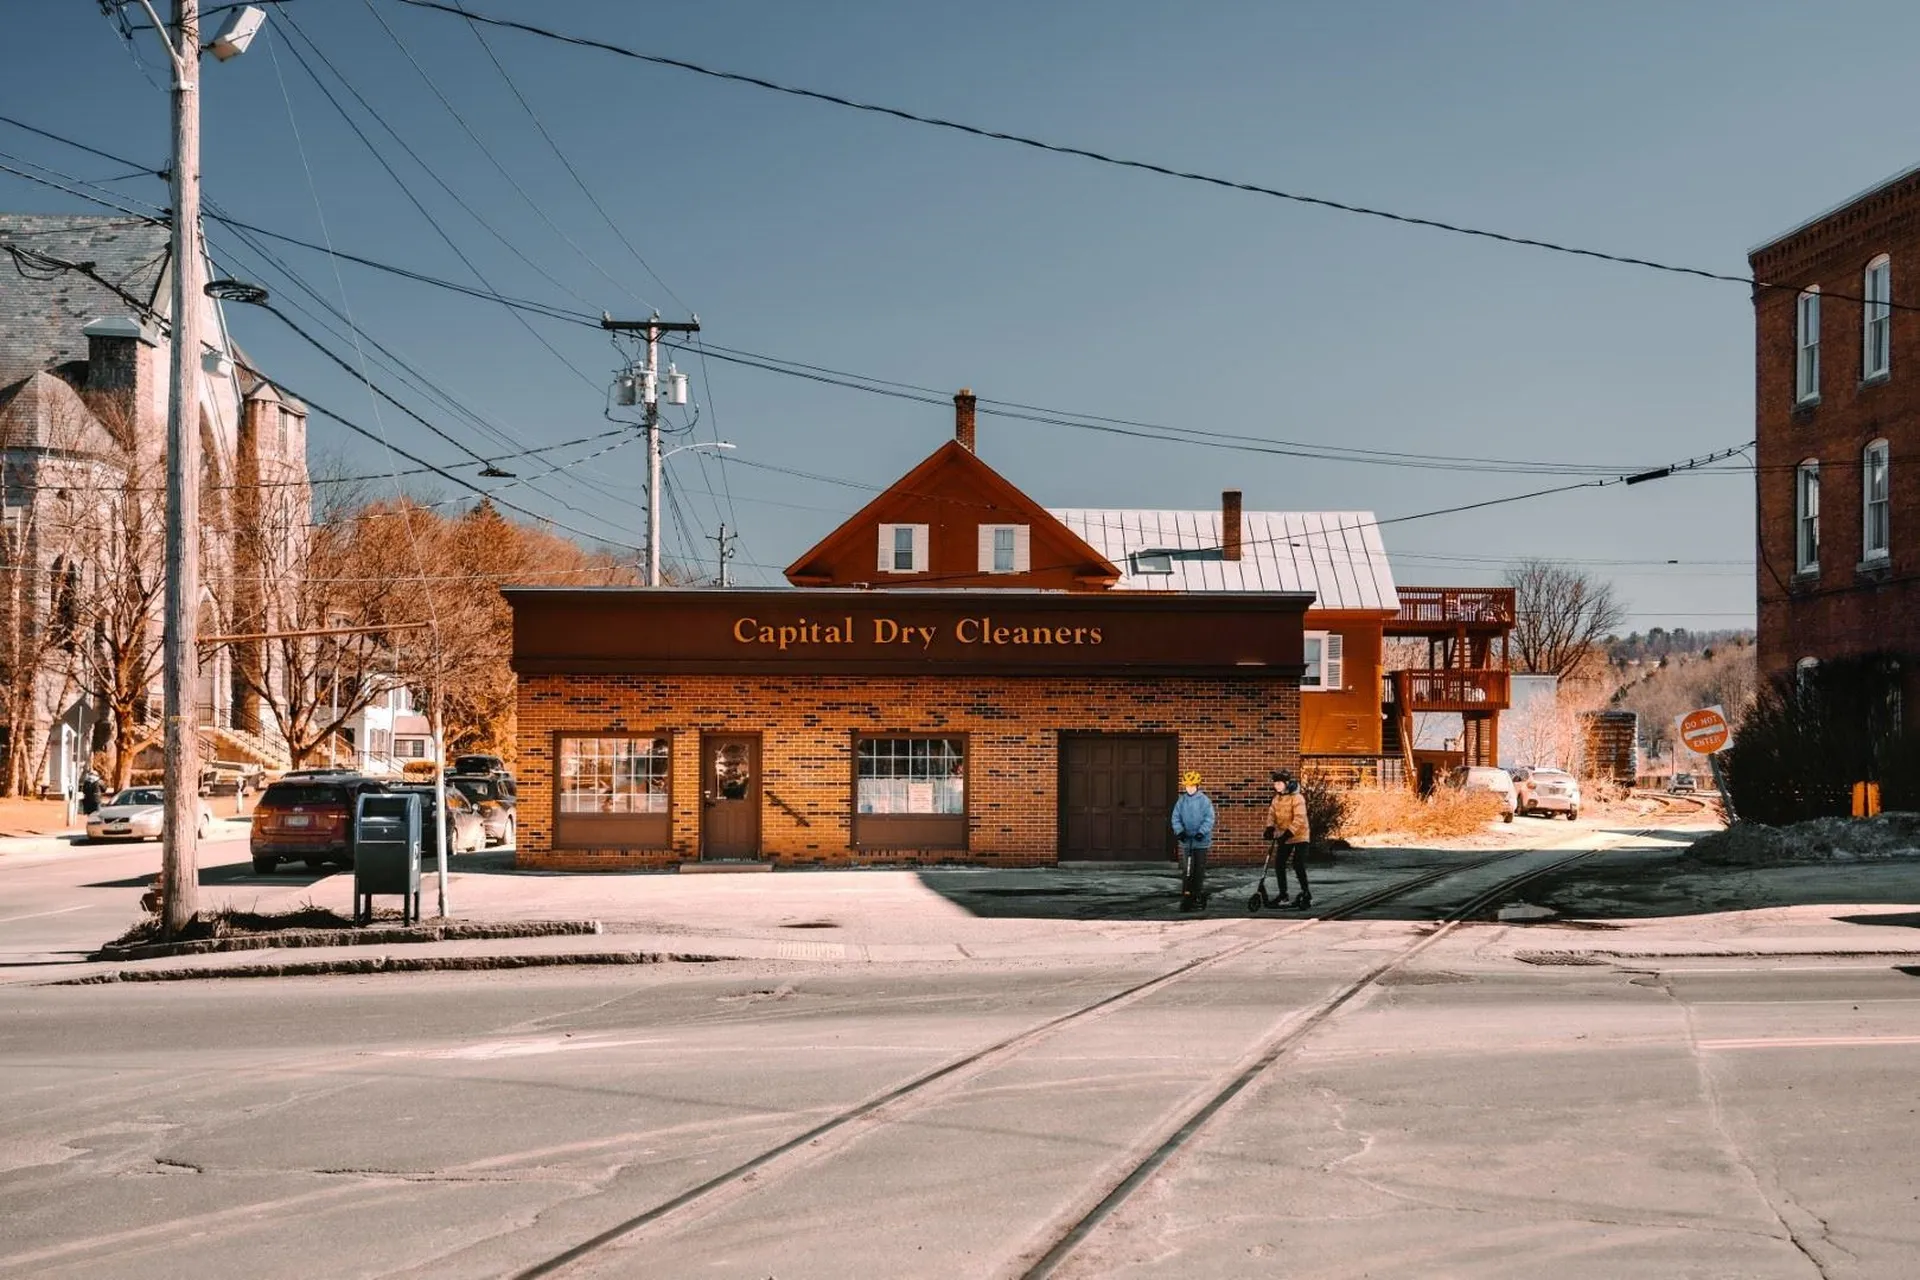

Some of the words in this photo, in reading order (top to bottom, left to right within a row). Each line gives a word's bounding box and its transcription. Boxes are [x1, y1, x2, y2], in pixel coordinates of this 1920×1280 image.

[733, 616, 855, 650] Capital
[873, 618, 937, 650] Dry
[955, 617, 1103, 645] Cleaners
[1684, 720, 1697, 730] DO
[1700, 715, 1718, 726] NOT
[1693, 736, 1721, 748] ENTER
